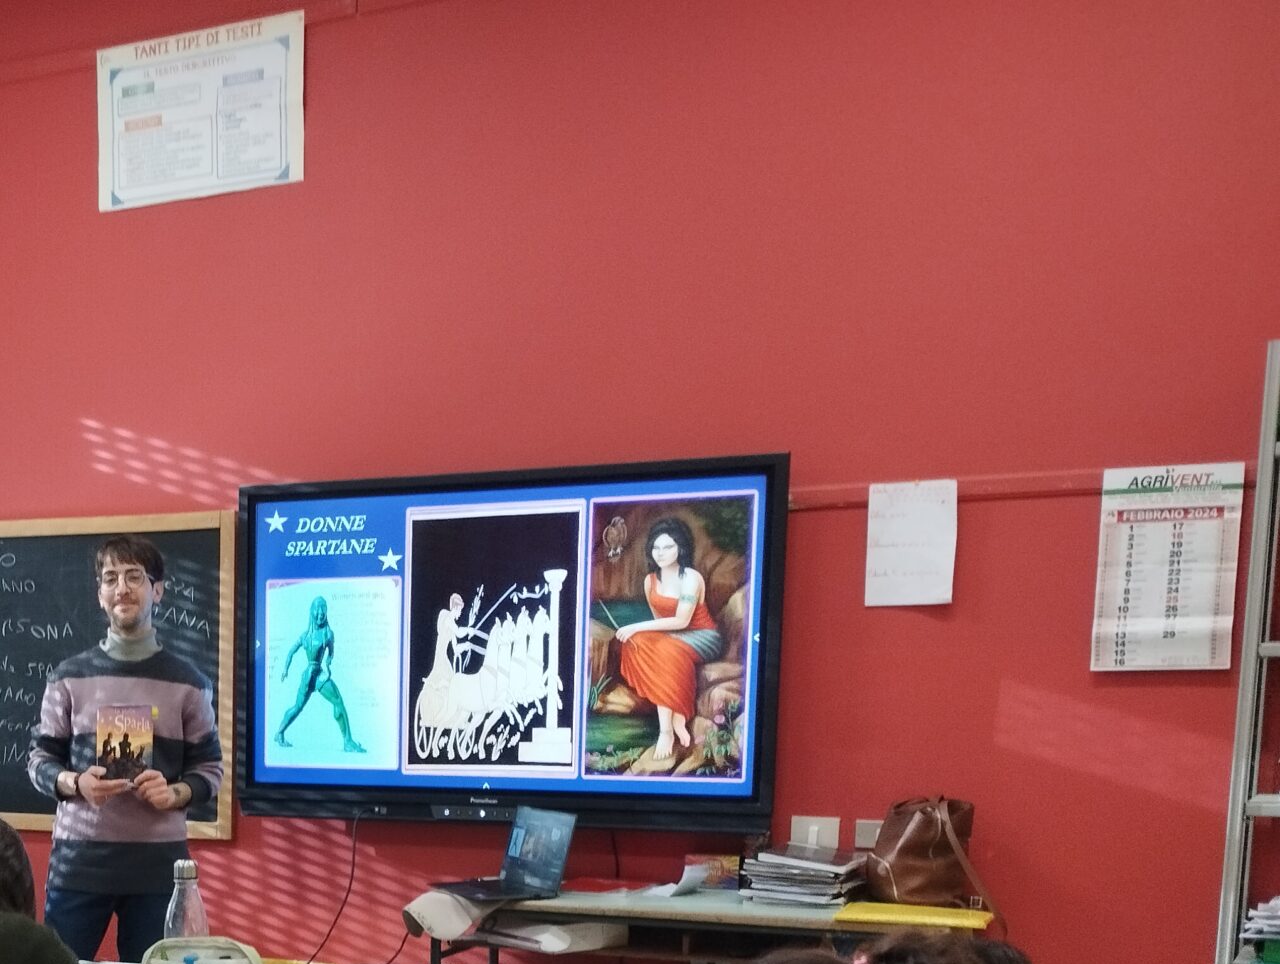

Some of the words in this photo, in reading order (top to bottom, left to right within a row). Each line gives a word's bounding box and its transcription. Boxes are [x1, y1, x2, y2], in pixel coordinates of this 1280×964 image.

[134, 40, 169, 60] TANTI
[176, 34, 200, 52] TIPI
[206, 30, 220, 46] DI
[226, 22, 263, 41] TESTI
[1127, 472, 1215, 490] AGRIVENT
[1122, 509, 1184, 521] FEBBRAIO
[1187, 507, 1219, 518] 2024
[295, 515, 367, 534] DONNE
[1173, 522, 1184, 530] 17
[285, 537, 378, 557] SPARTANE
[1171, 541, 1183, 549] 19
[1169, 550, 1182, 558] 20
[1169, 559, 1180, 567] 21
[1168, 568, 1181, 576] 22
[1167, 577, 1180, 585] 23
[1167, 586, 1179, 594] 24
[1118, 605, 1129, 613] 10
[1165, 605, 1178, 613] 26
[1115, 632, 1126, 640] 13
[1162, 631, 1176, 639] 29
[1115, 640, 1126, 648] 14
[1114, 658, 1125, 666] 16
[27, 662, 56, 679] SPA
[114, 714, 151, 734] Sparta
